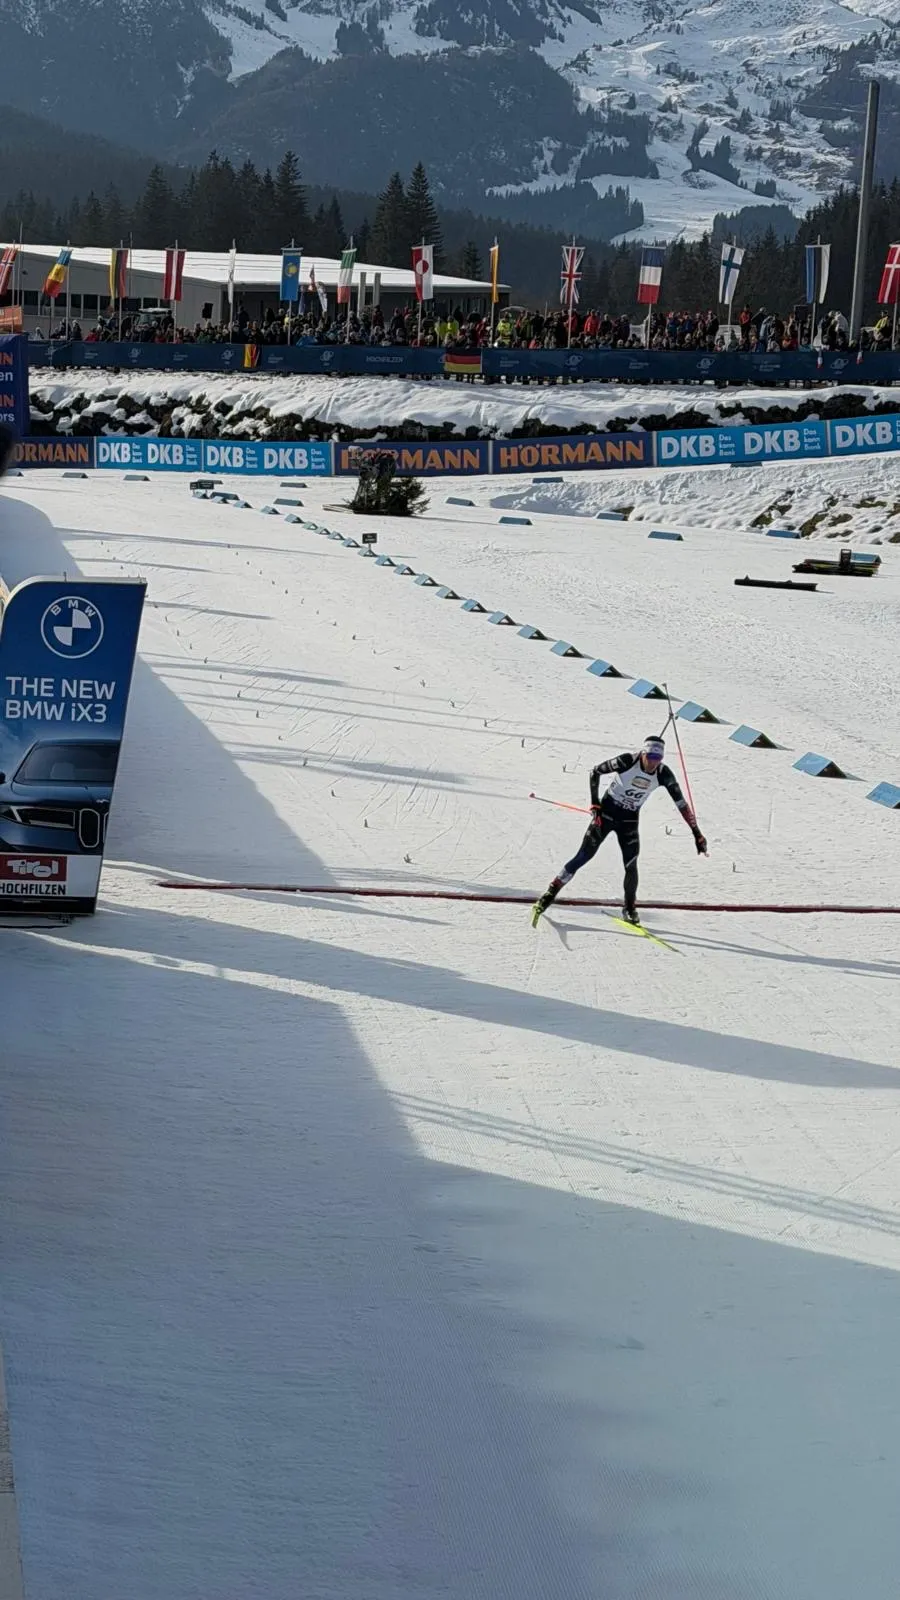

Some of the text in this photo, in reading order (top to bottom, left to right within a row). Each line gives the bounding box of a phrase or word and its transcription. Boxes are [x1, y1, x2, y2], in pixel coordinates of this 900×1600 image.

[744, 430, 800, 455] DKB
[836, 421, 893, 448] DKB
[98, 442, 131, 463] DKB
[147, 443, 184, 465] DKB
[206, 445, 244, 468] DKB
[263, 448, 308, 469] DKB
[499, 440, 644, 468] HÖRMANN
[661, 435, 716, 459] DKB
[50, 600, 96, 617] BMW
[5, 676, 116, 700] THE NEW
[5, 699, 107, 723] BMW iX3
[0, 882, 66, 895] HOCHFILZEN
